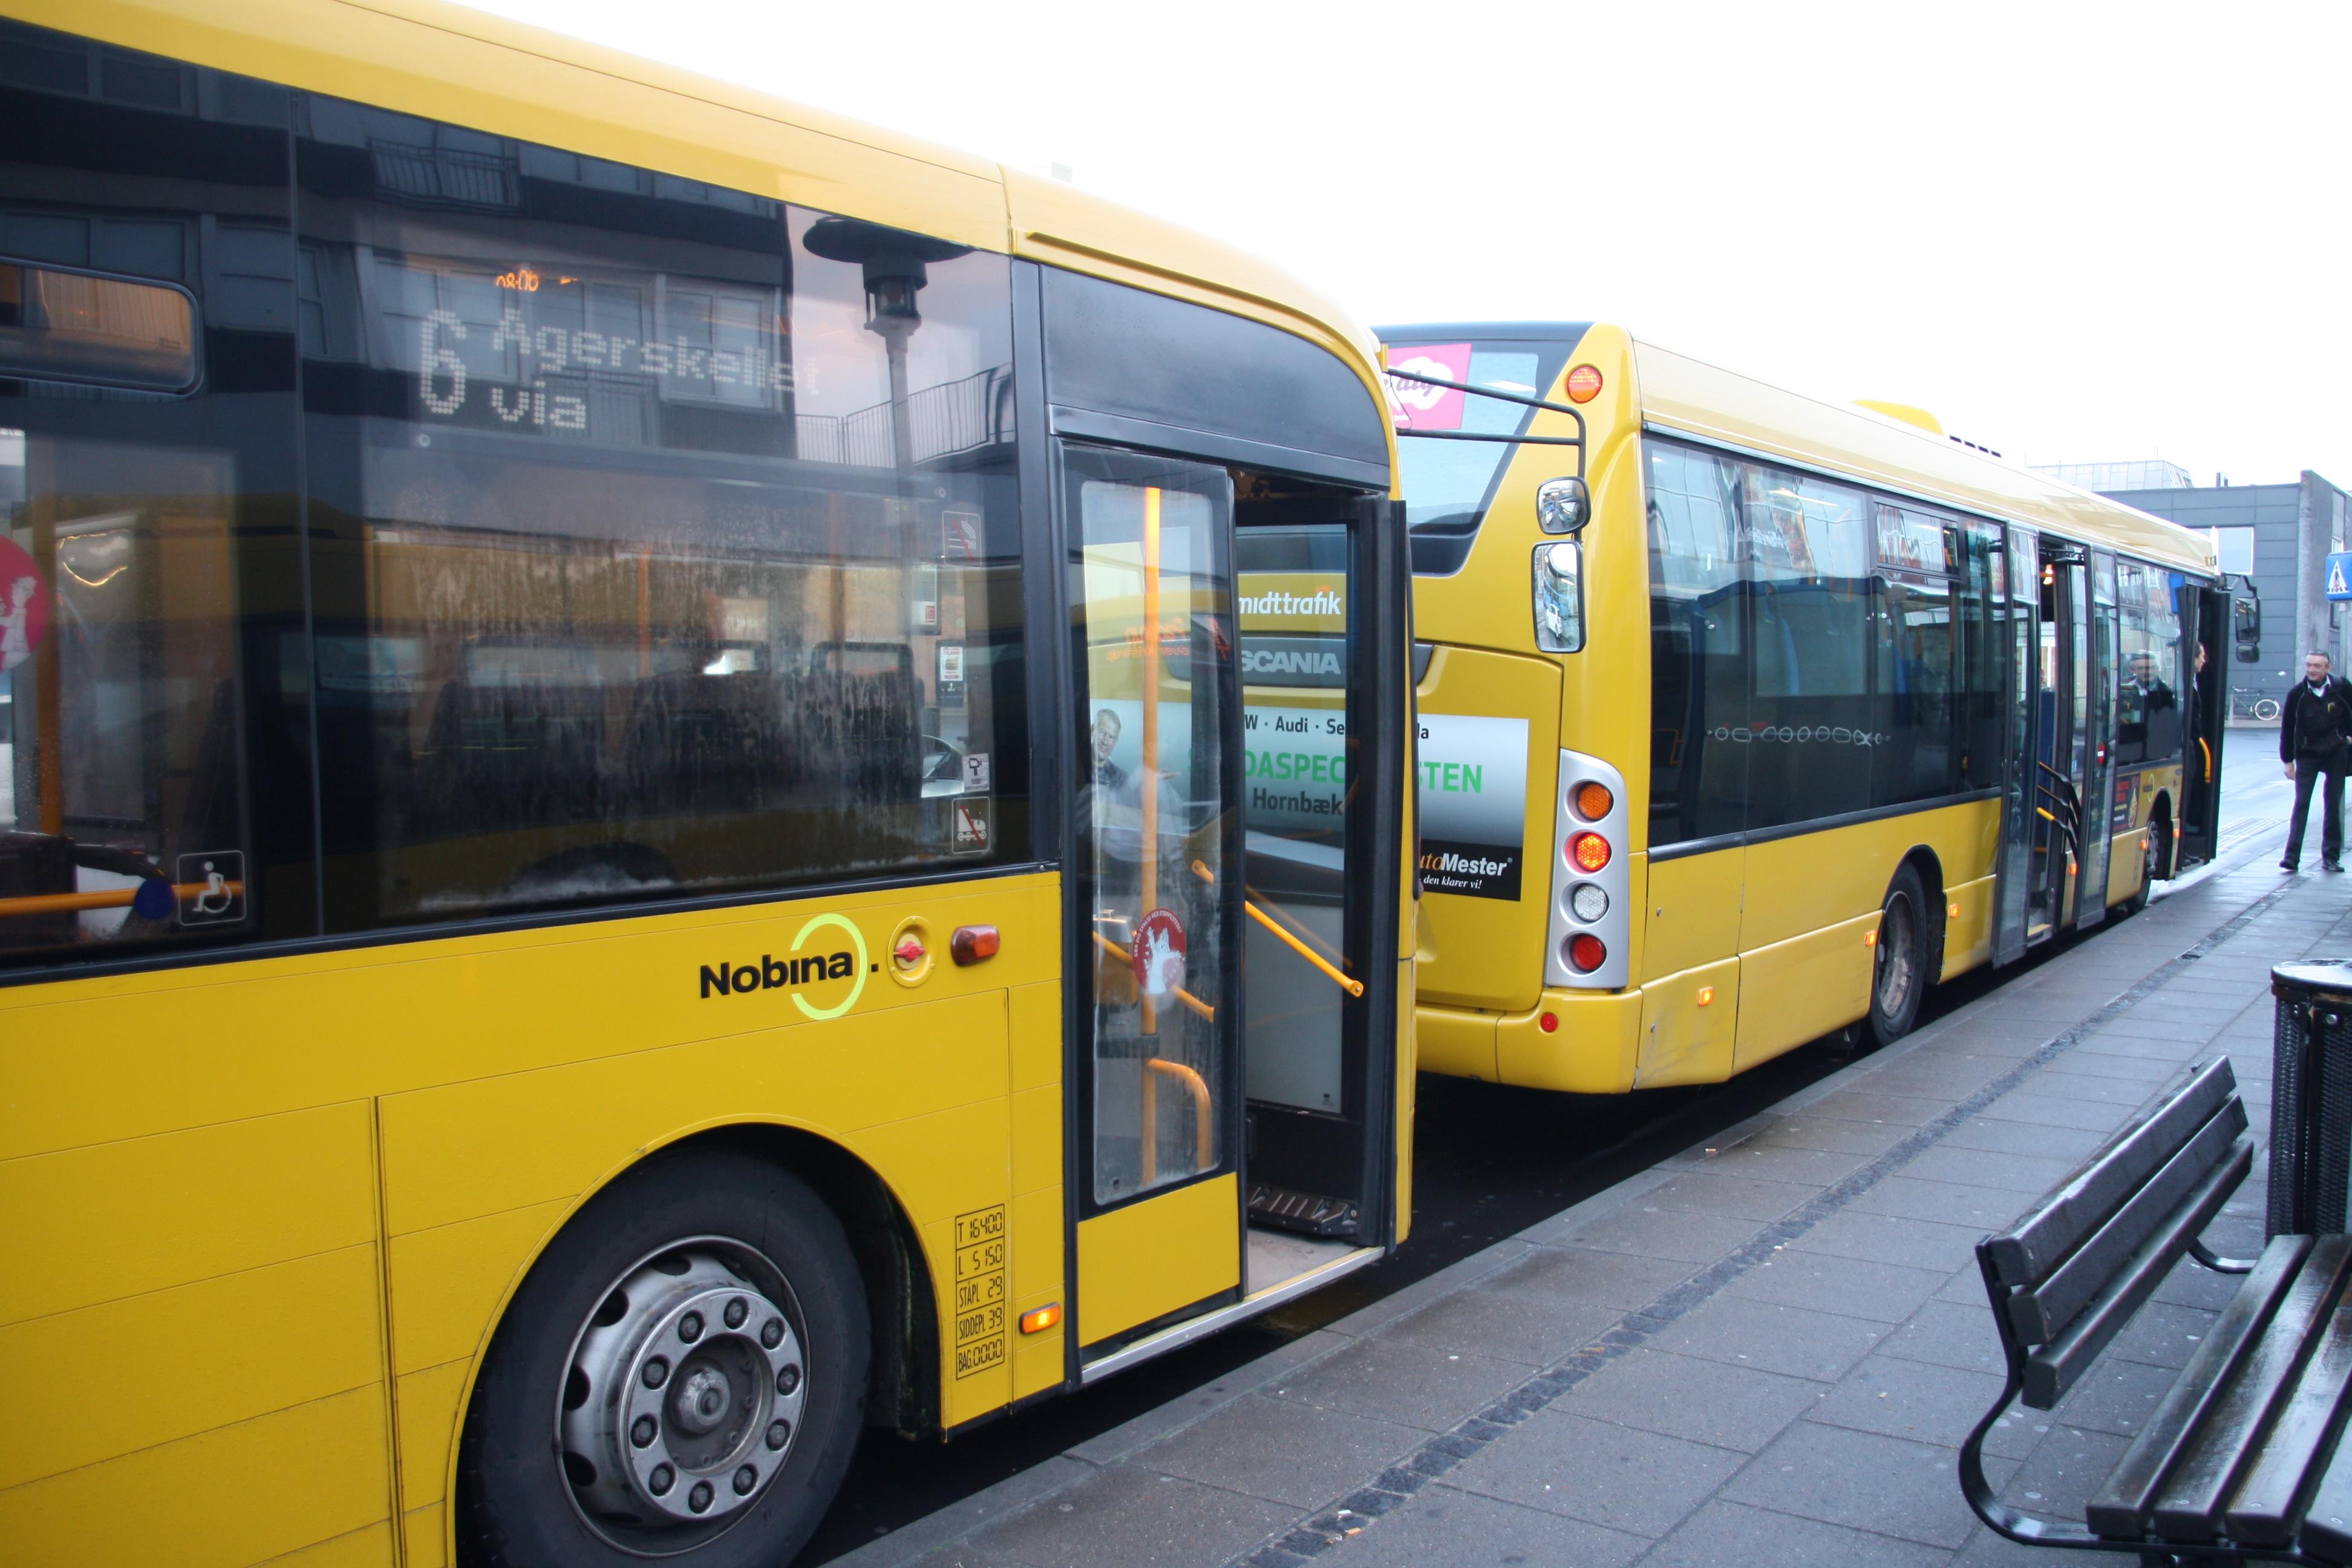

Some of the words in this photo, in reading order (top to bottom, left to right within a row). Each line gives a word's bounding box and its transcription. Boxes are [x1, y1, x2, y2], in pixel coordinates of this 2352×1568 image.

[420, 309, 466, 416] 6
[491, 380, 586, 430] via
[1241, 650, 1342, 675] SCANIA
[1275, 716, 1308, 733] Audi
[1326, 718, 1345, 736] Se
[1253, 787, 1344, 816] Hornbæk
[1423, 875, 1439, 885] den
[1442, 876, 1468, 888] klarer
[1471, 880, 1482, 889] vi!
[958, 1221, 964, 1243] T
[970, 1212, 1003, 1240] 16400
[959, 1255, 964, 1275] L
[959, 1281, 980, 1308] STÅPL
[988, 1276, 1003, 1298] 29
[959, 1314, 985, 1340] SIDDEPL
[988, 1307, 1003, 1330] 39
